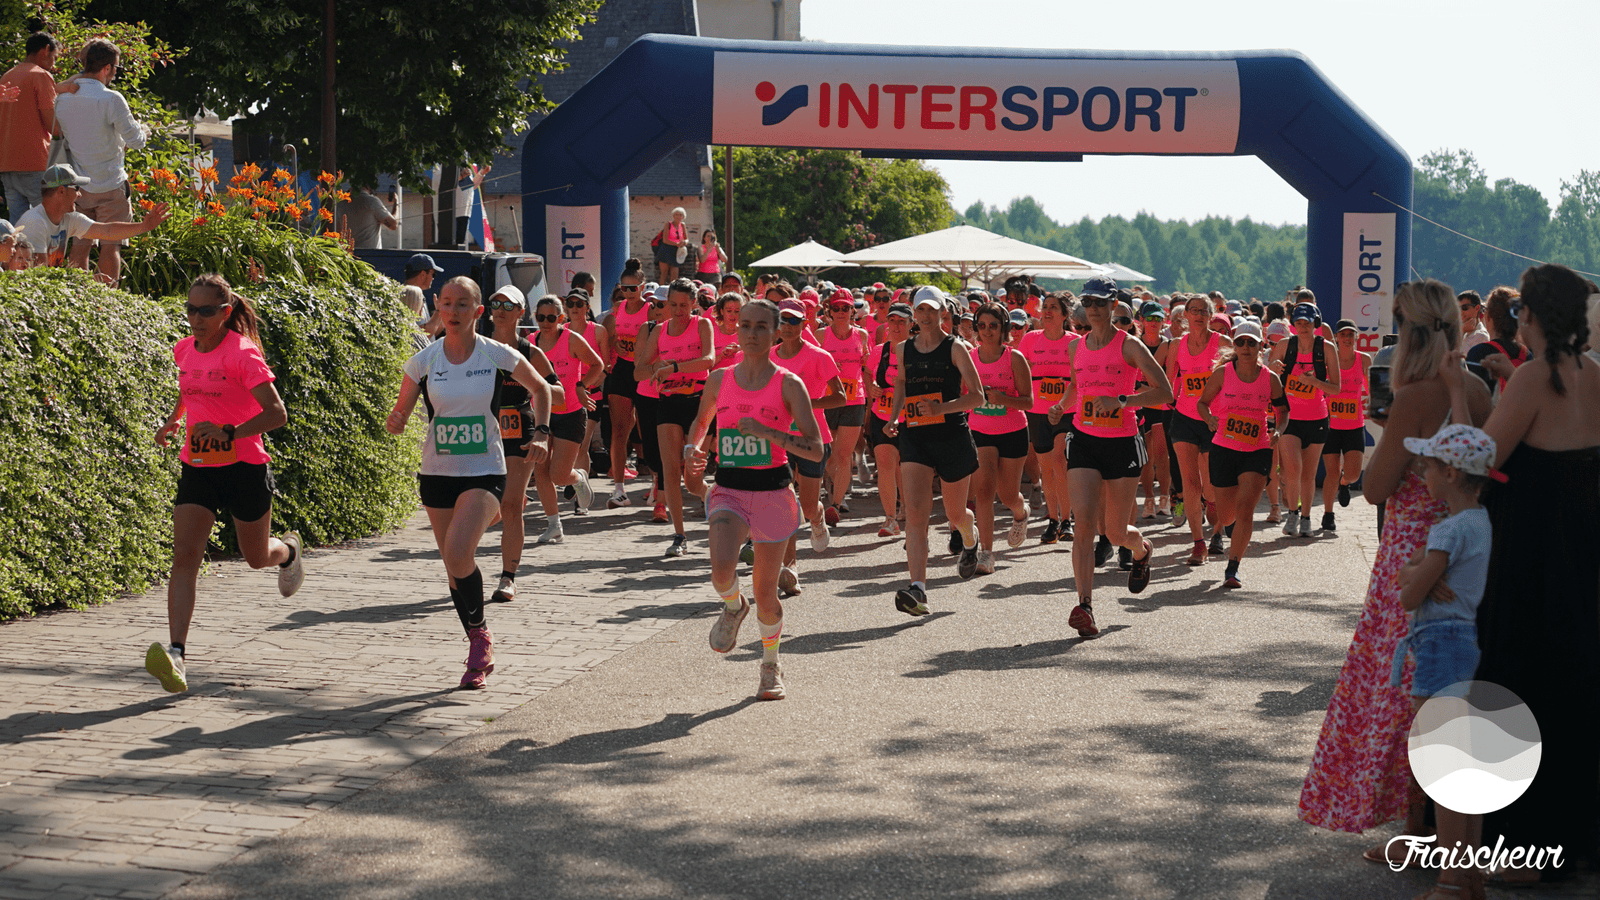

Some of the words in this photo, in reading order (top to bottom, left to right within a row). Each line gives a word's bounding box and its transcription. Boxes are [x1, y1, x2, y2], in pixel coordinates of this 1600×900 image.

[819, 82, 1198, 132] INTERSPORT
[1040, 382, 1065, 394] 9067
[1186, 376, 1209, 391] 931
[1331, 401, 1356, 414] 9018
[501, 415, 519, 430] 03
[1226, 418, 1260, 438] 9338
[436, 423, 484, 444] 8238
[722, 436, 767, 456] 8261
